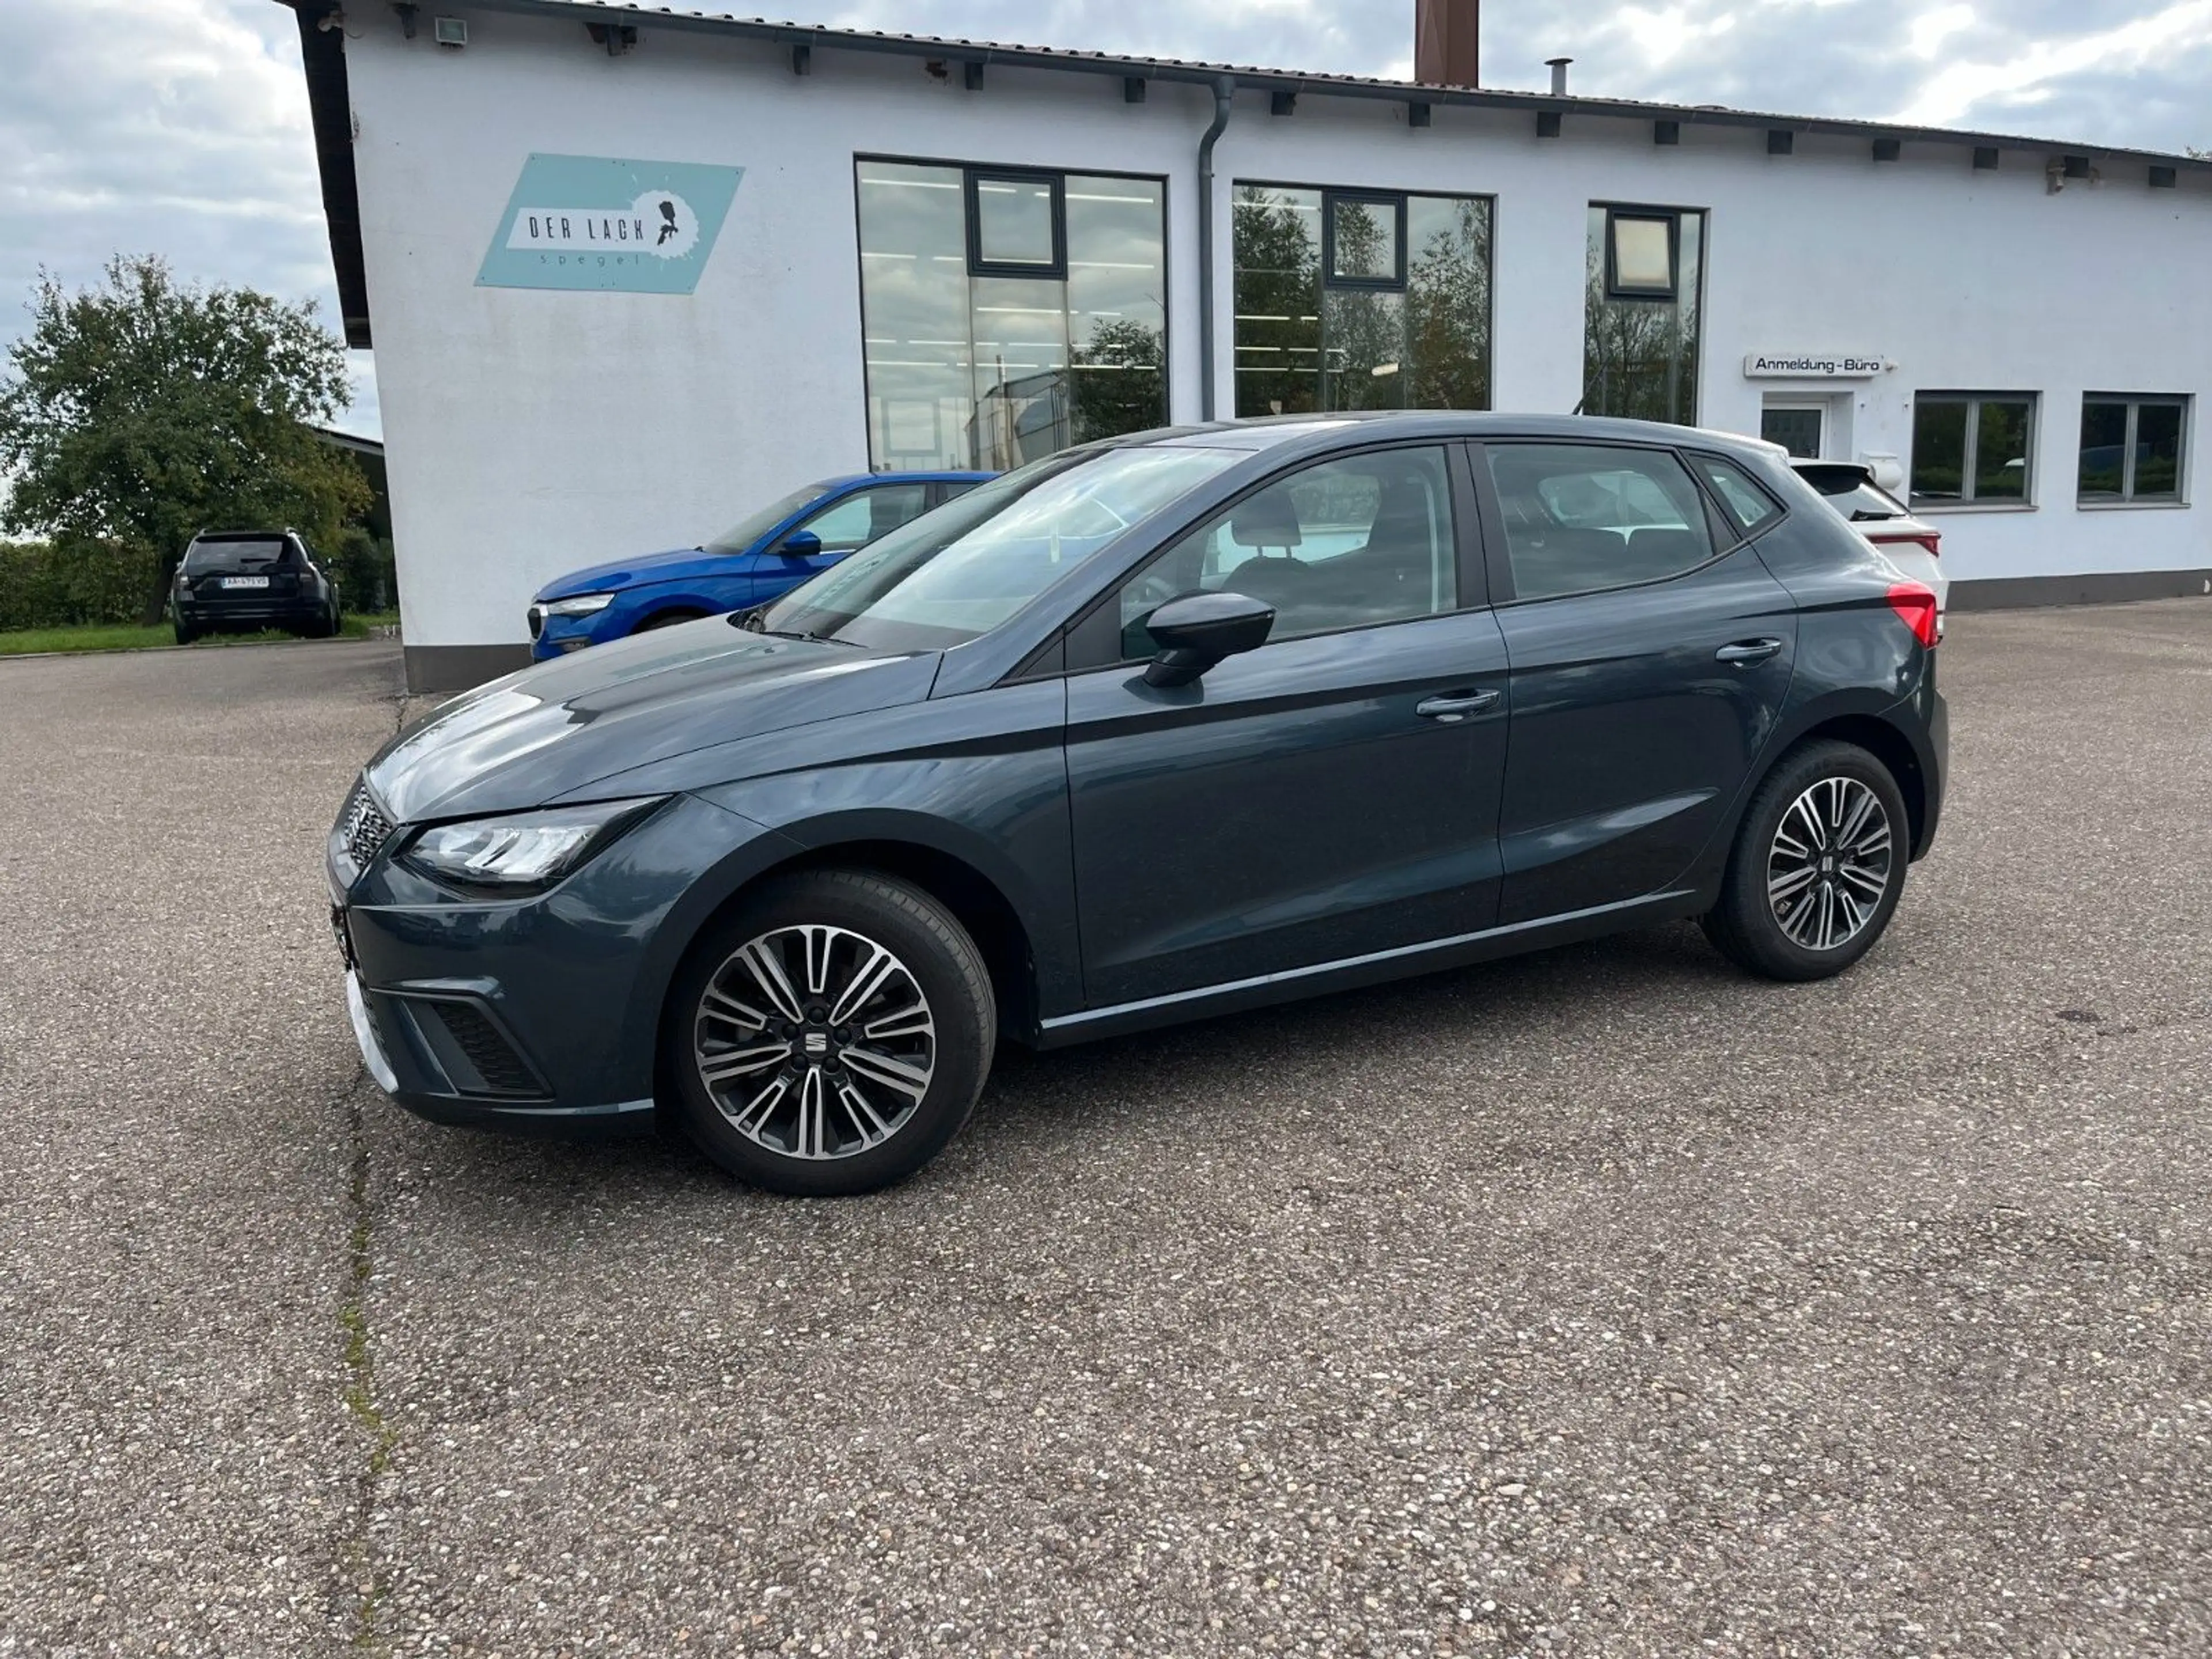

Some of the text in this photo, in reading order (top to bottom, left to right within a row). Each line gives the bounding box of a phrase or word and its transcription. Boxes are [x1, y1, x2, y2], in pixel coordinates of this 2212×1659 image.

[529, 216, 644, 240] DER LACK
[540, 253, 639, 267] spegel
